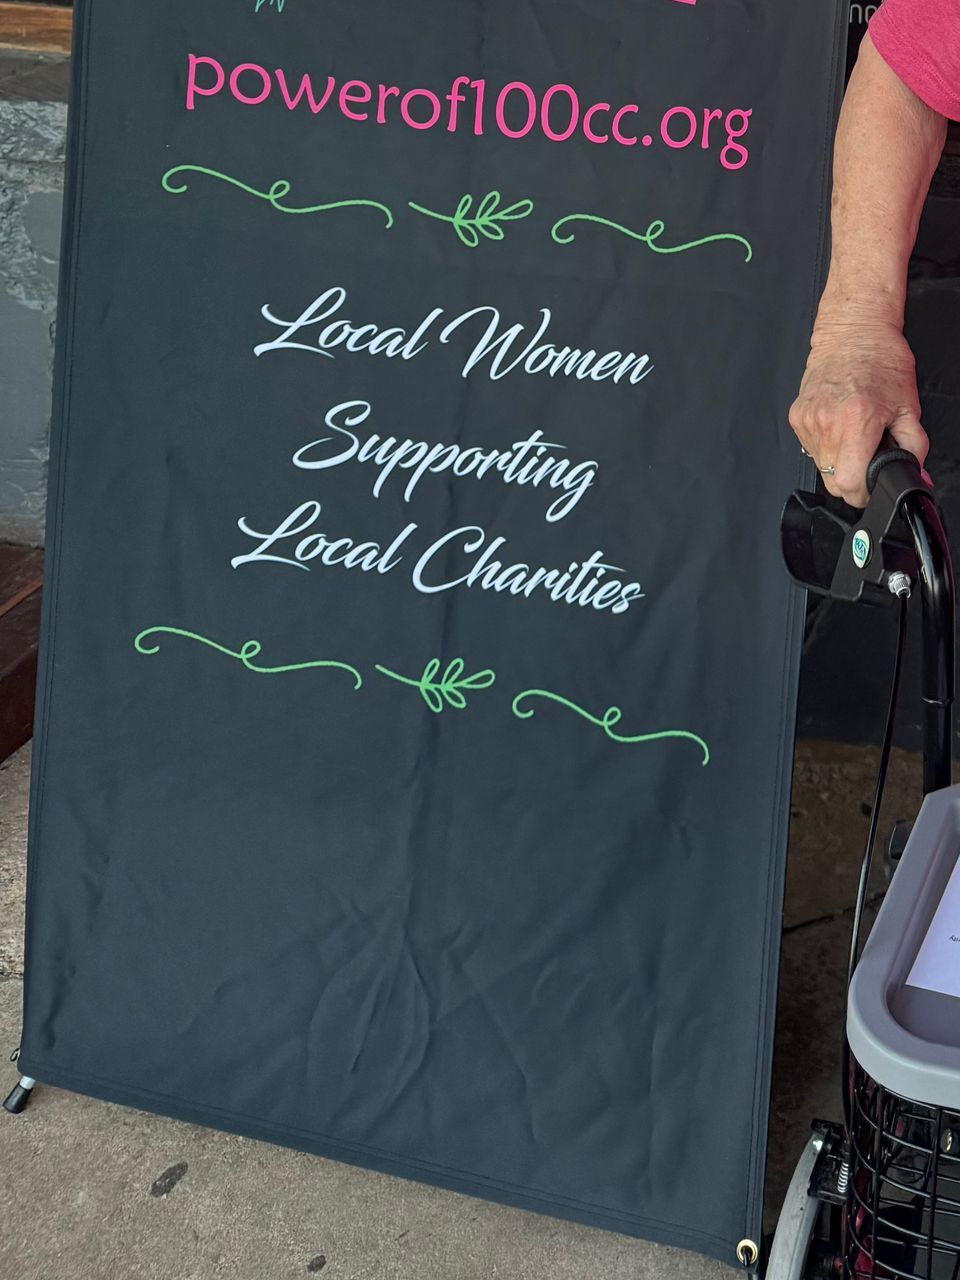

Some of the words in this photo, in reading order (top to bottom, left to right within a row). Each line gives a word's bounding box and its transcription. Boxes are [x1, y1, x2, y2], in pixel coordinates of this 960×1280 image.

[186, 53, 752, 170] powerof100cc.org
[253, 286, 444, 360] Local
[440, 305, 654, 385] Women
[292, 400, 599, 522] Supporting
[230, 500, 417, 575] Local
[411, 525, 646, 615] Charities
